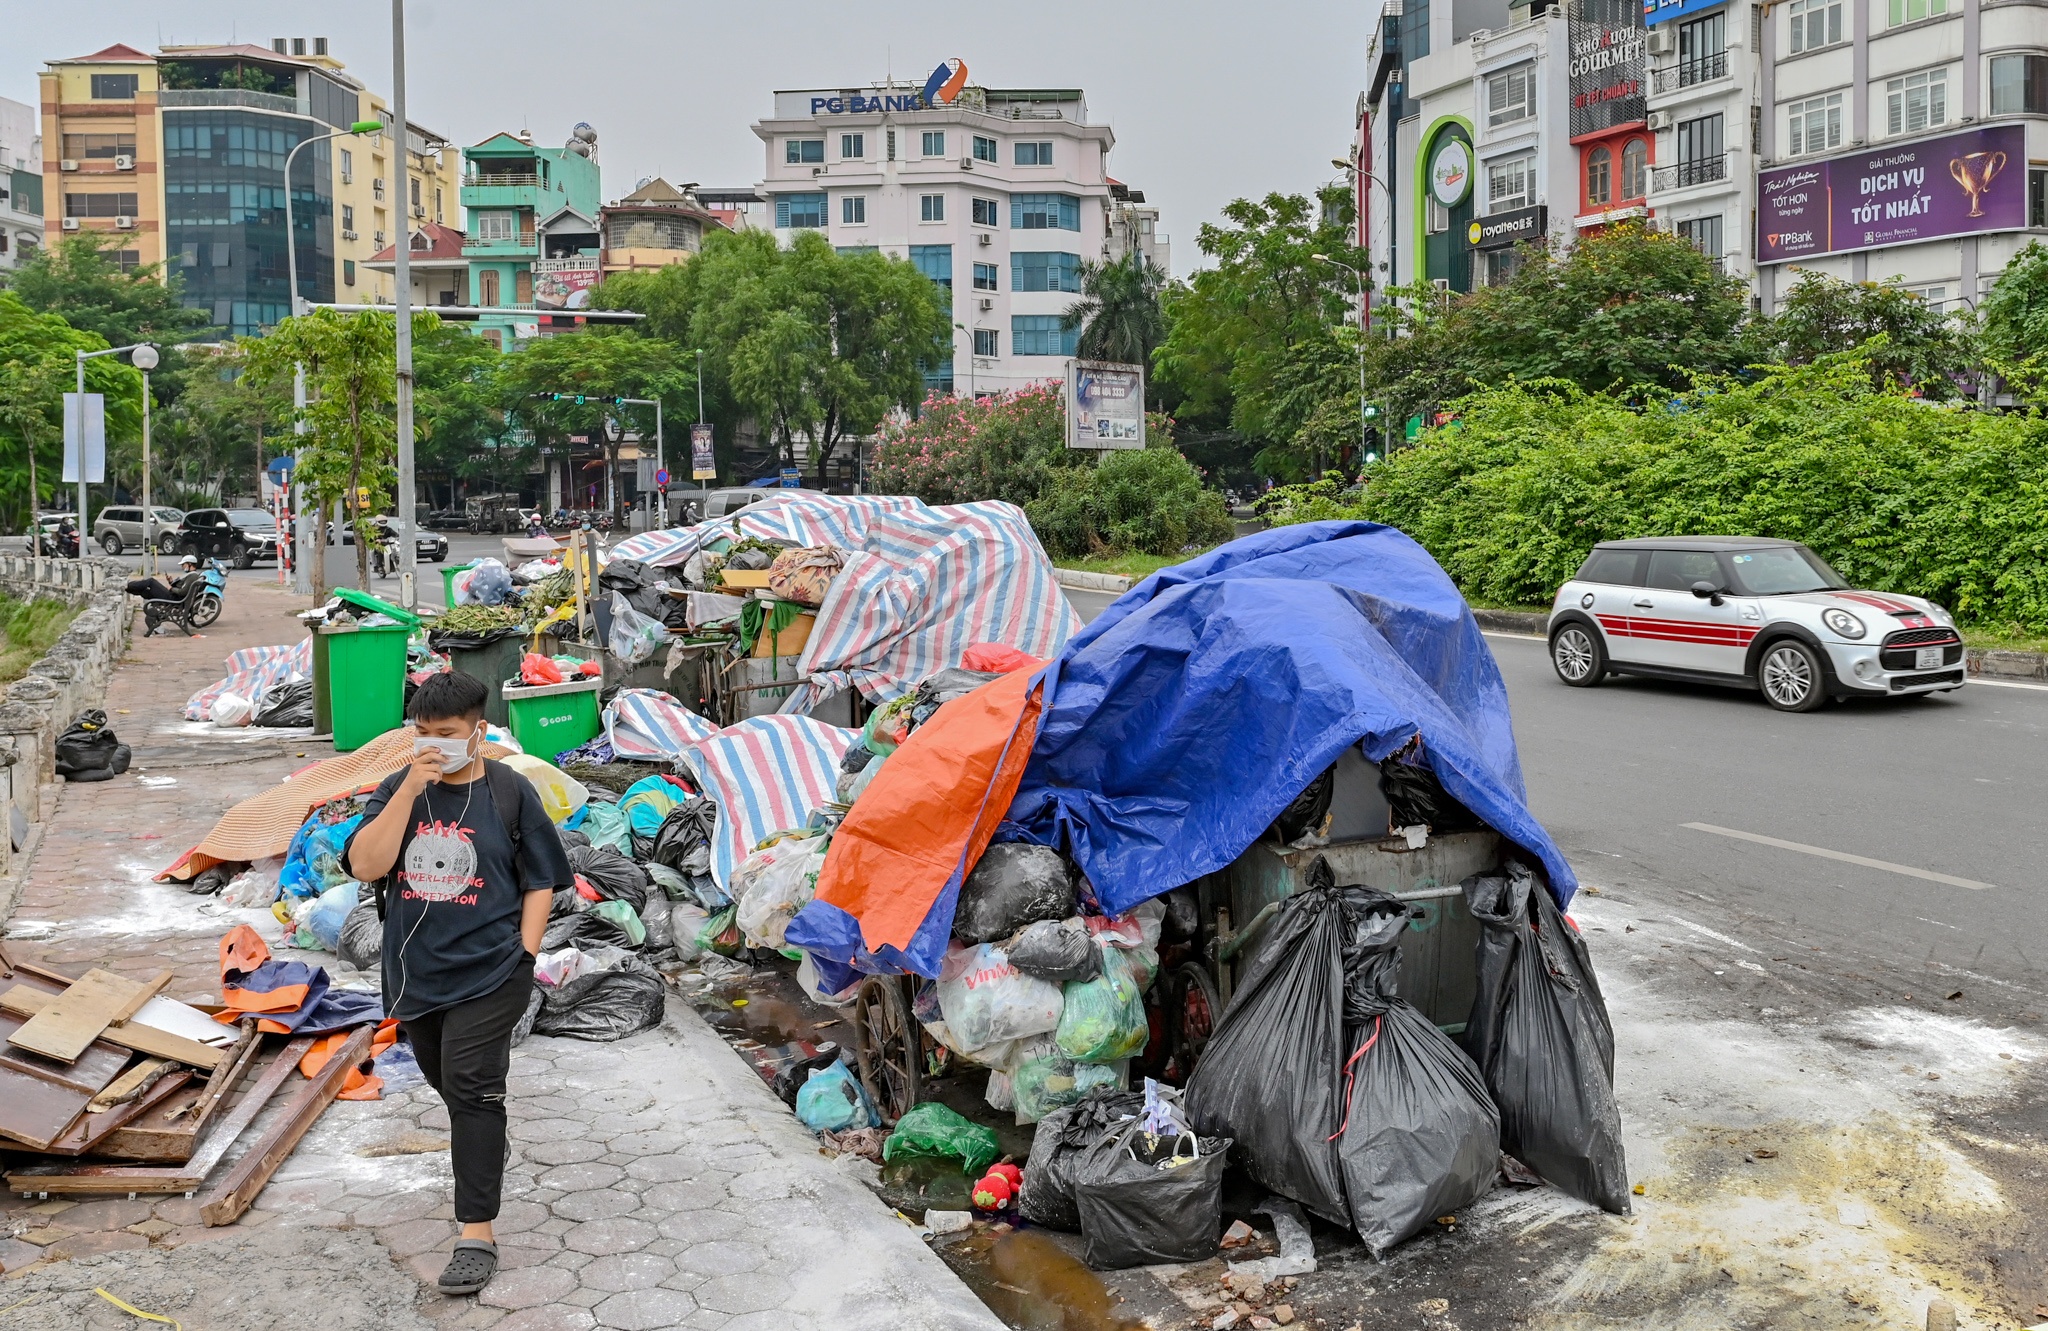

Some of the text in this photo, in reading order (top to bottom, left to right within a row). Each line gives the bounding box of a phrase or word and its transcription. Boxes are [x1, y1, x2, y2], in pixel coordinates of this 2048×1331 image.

[1575, 38, 1600, 56] KHO
[1569, 39, 1643, 77] GOURMET
[811, 94, 920, 115] PG BANK
[1869, 153, 1916, 170] GIẢI THƯỞNG
[1860, 167, 1925, 197] DỊCH VỤ
[1771, 193, 1808, 208] TỐT HƠN
[1851, 190, 1932, 225] TỐT NHẤT
[1791, 206, 1804, 215] ngày
[1482, 220, 1519, 238] royaltea
[1779, 230, 1813, 246] TPBank
[575, 395, 585, 405] 30
[414, 820, 476, 843] KMC
[397, 871, 485, 889] POWERLIFTING
[401, 889, 478, 906] COMPETITION
